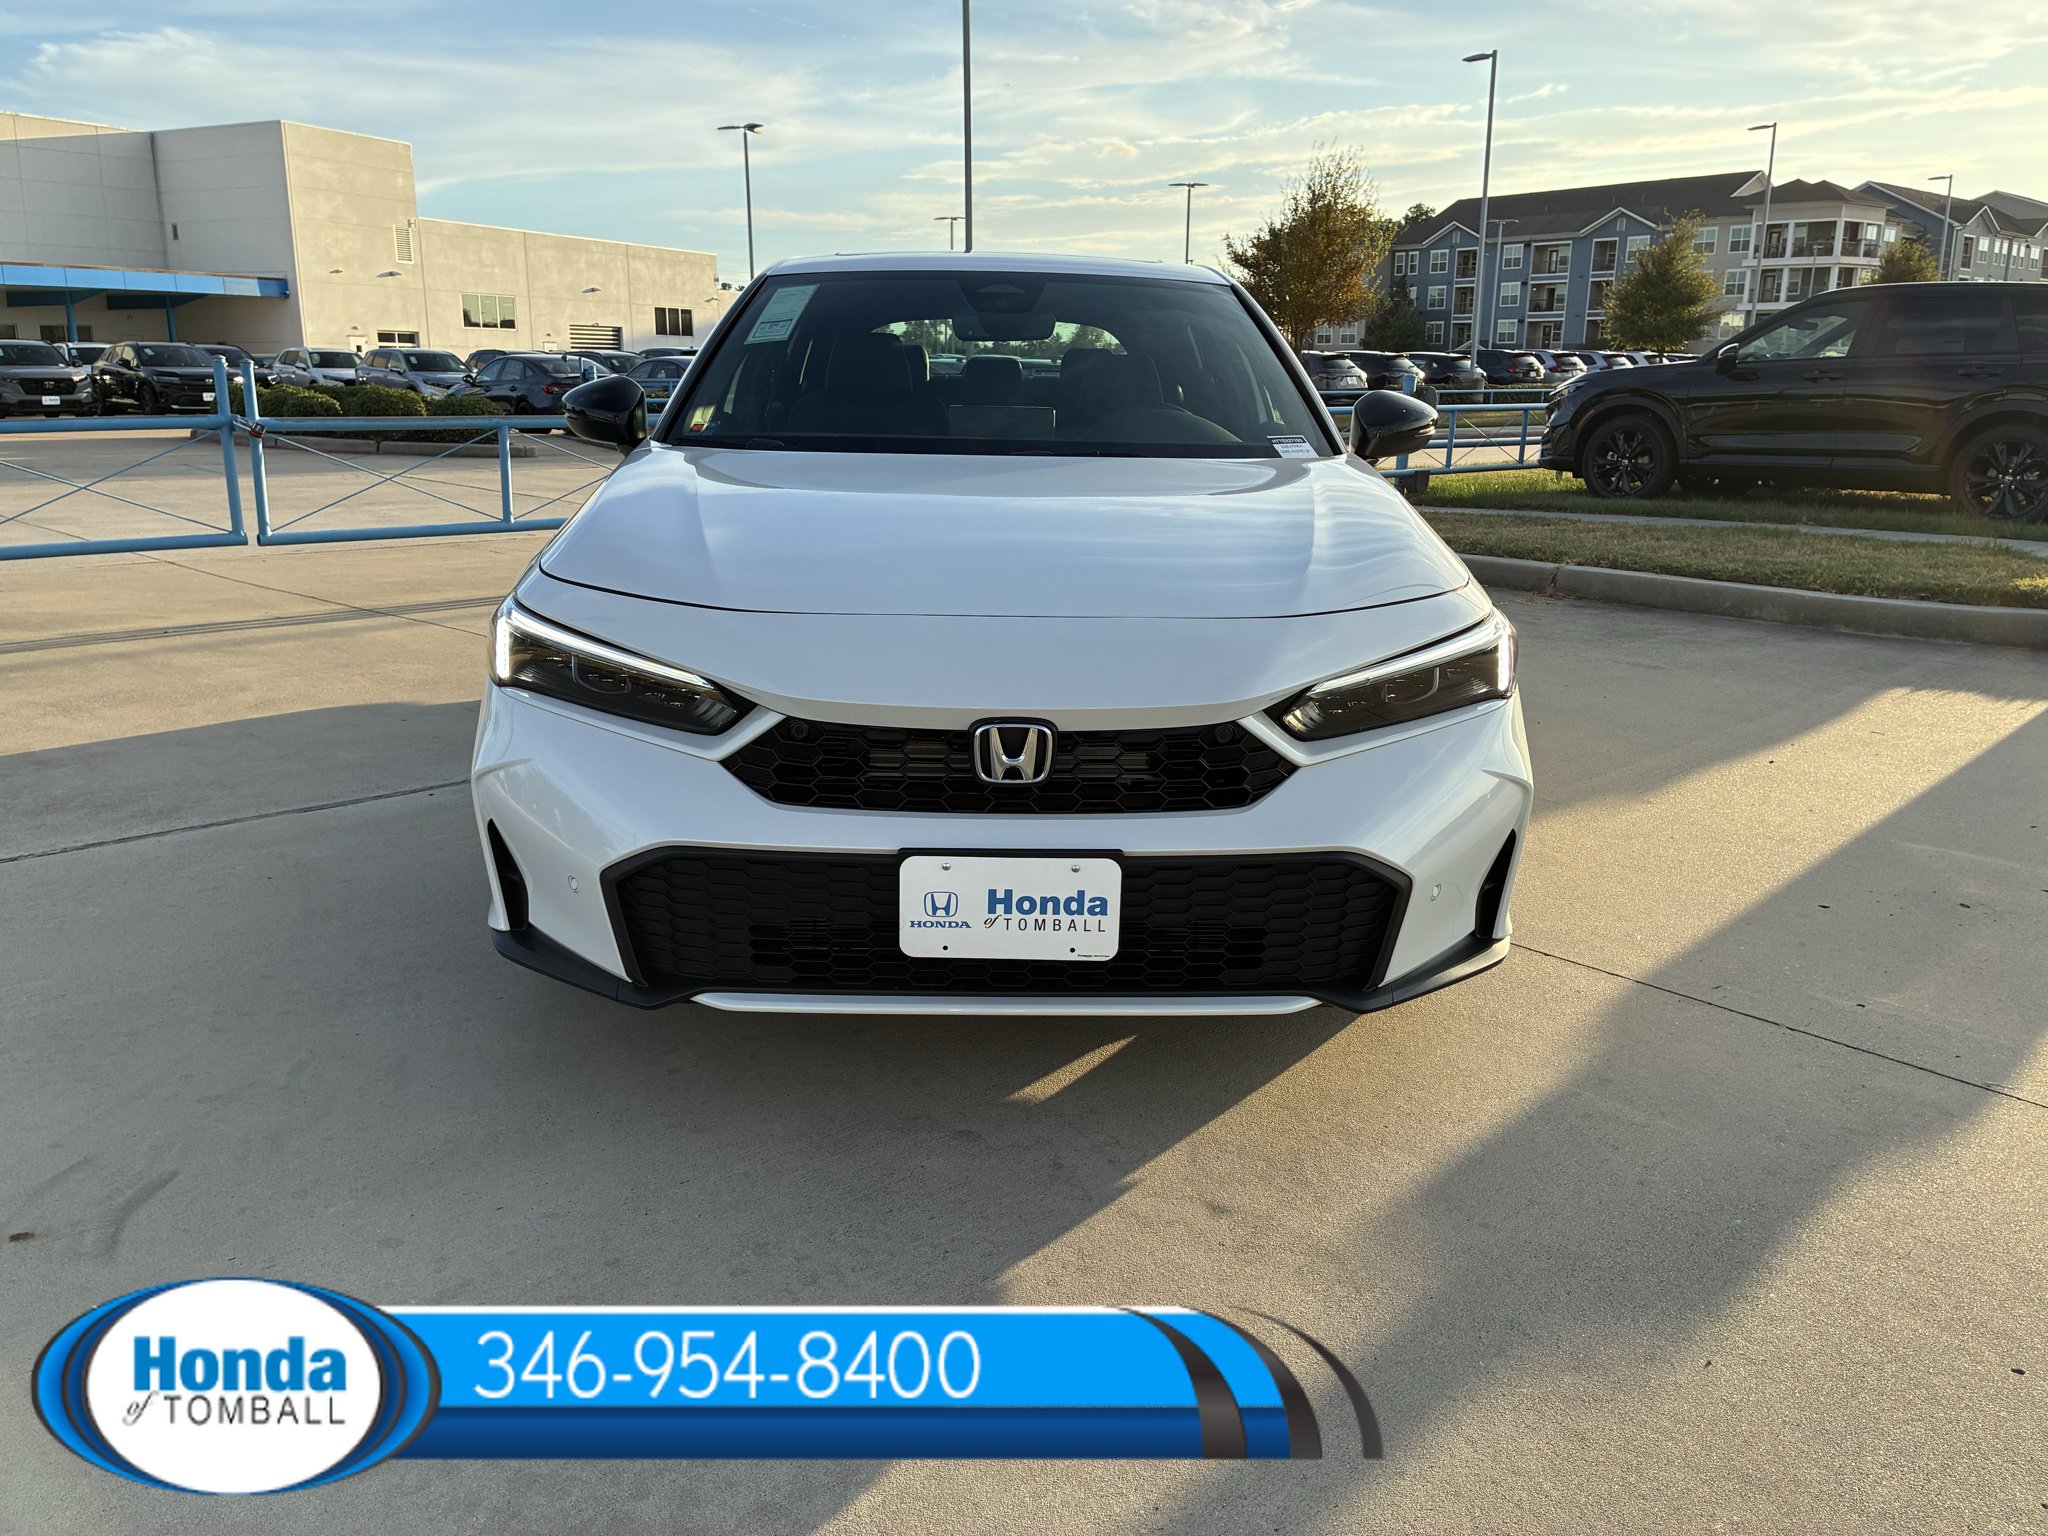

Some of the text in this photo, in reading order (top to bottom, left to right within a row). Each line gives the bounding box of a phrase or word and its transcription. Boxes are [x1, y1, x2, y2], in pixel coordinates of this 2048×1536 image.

[987, 888, 1109, 917] Honda
[909, 920, 972, 929] HONDA
[983, 915, 1106, 933] of TOMBALL
